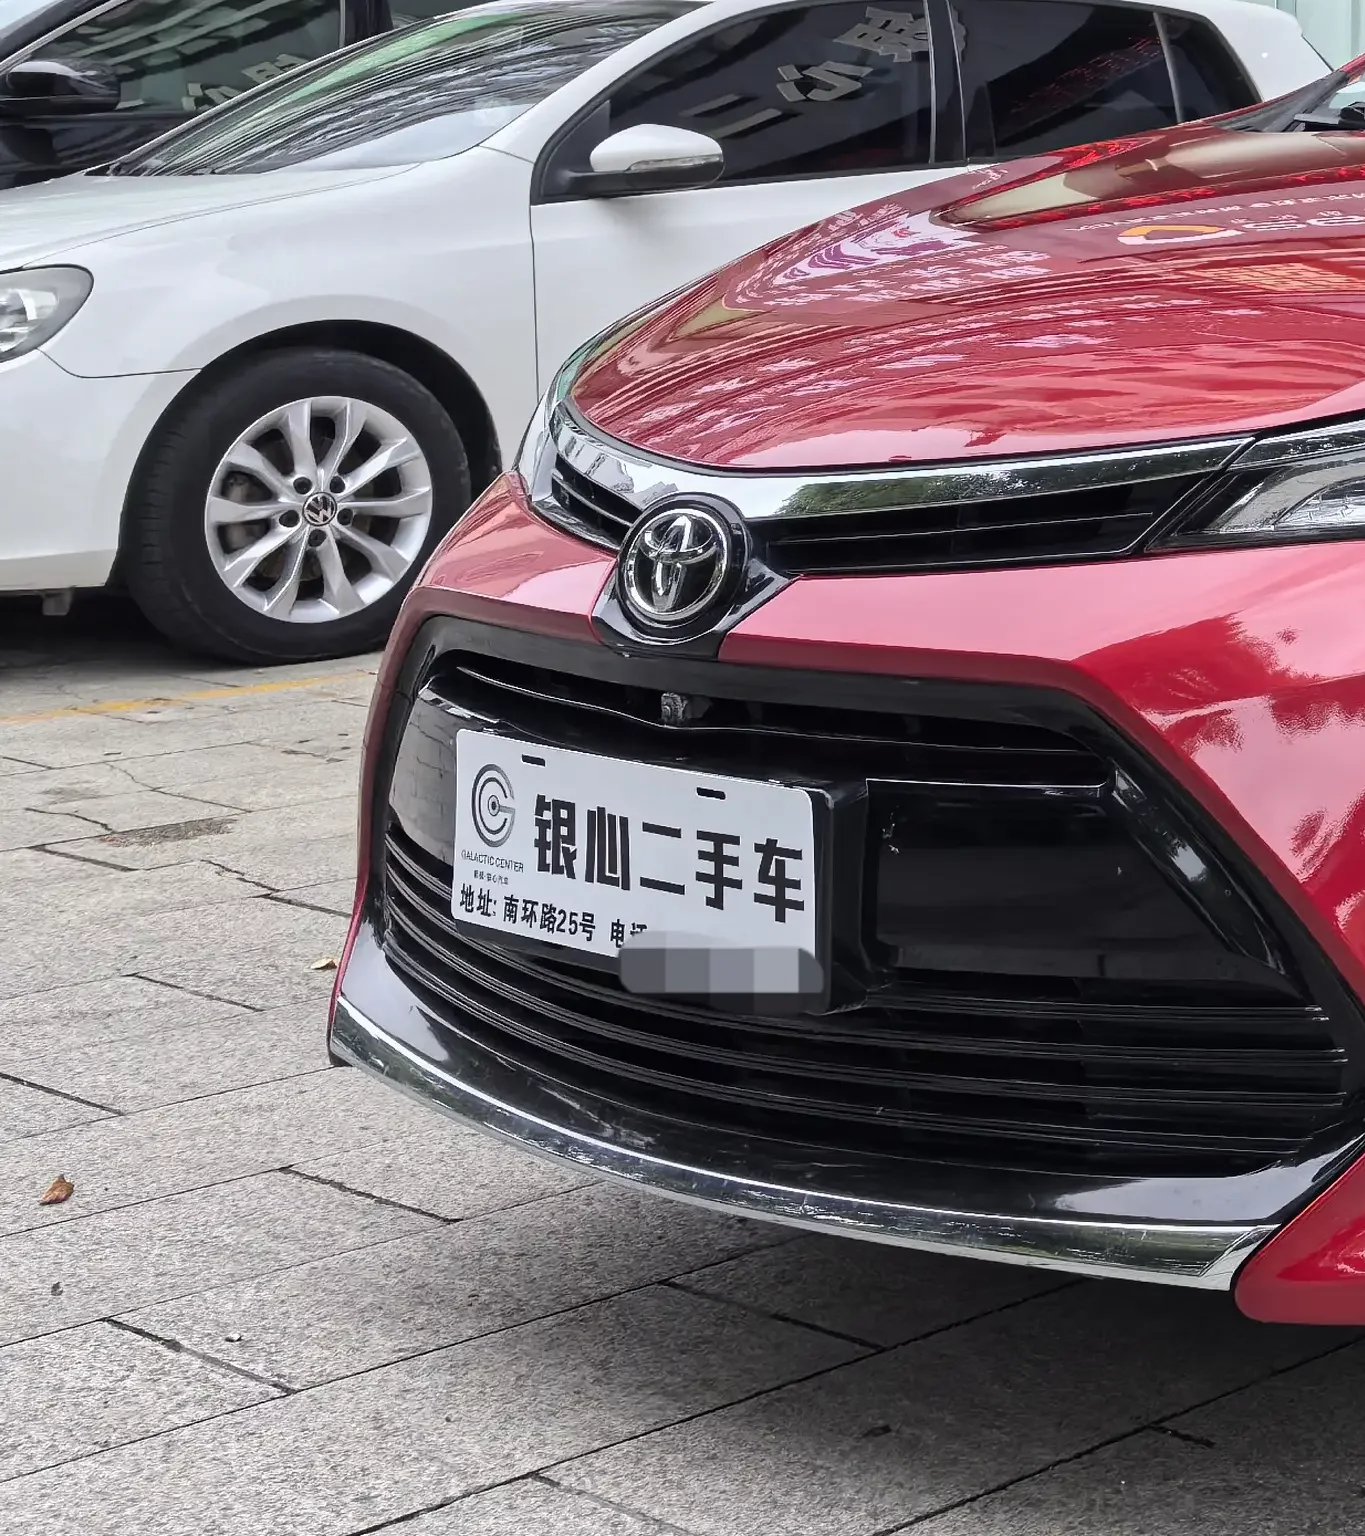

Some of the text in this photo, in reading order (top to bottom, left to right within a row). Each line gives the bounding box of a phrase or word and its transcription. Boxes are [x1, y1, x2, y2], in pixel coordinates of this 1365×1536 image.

[533, 793, 805, 924] 银心二手车
